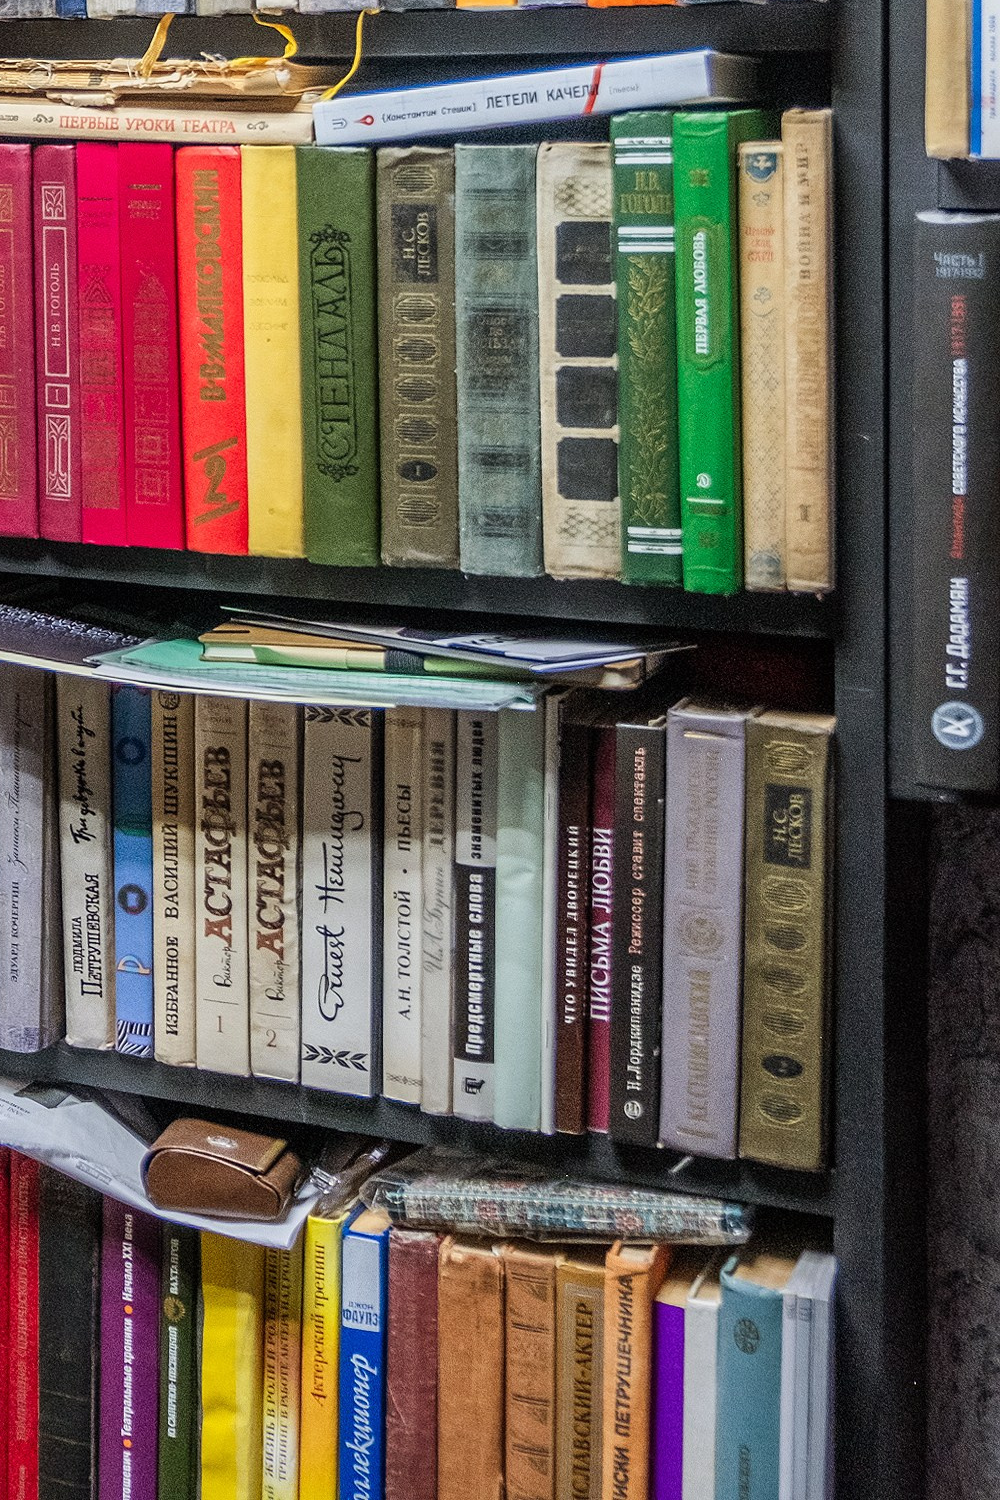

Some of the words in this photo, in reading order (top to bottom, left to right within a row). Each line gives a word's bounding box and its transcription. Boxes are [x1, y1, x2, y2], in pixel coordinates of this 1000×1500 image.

[59, 115, 119, 130] ПЕРВЫЕ
[125, 116, 176, 132] УРОКИ
[182, 119, 236, 134] ТЕАТРА
[418, 212, 429, 276] ЛЕСКОВ
[693, 232, 707, 295] ЛЮБОВЬ
[50, 263, 60, 316] ГОГОЛЬ
[51, 321, 61, 347] Н.В.
[695, 298, 709, 354] ПЕРВАЯ
[946, 576, 968, 659] ДАДАМЯН
[946, 662, 968, 691] Г.Г.
[163, 714, 178, 818] ШУКШИН
[472, 720, 483, 770] людей
[201, 745, 237, 947] АСТАФЬЕВ
[315, 754, 364, 905] Hemingway
[397, 784, 411, 852] ПЬЕСЫ
[471, 775, 482, 860] знаменитых
[787, 793, 806, 862] ЛЕСКОВ
[164, 824, 178, 920] ВАСИЛИЙ
[253, 758, 286, 961] АСТАФЬЕВ
[566, 825, 579, 921] ДВОРЕЦКИЙ
[591, 827, 612, 913] ЛЮБВИ
[468, 873, 482, 924] слова
[71, 916, 84, 974] ЛЮДМИЛА
[397, 891, 411, 979] ТОЛСТОЙ
[564, 927, 577, 987] УВИДЕЛ
[166, 935, 178, 1037] ИЗБРАННОЕ
[213, 945, 233, 988] Виктор
[265, 959, 285, 1001] Виктор
[317, 925, 345, 1022] Ernest
[399, 985, 411, 1002] Н.
[465, 928, 483, 1055] Предсмертные
[589, 921, 611, 1022] ПИСЬМА
[216, 1015, 224, 1034] 1
[265, 1028, 277, 1050] 2
[400, 1003, 411, 1021] А.
[564, 994, 576, 1024] ЧТО
[123, 1213, 133, 1240] века
[122, 1261, 133, 1301] Начало
[169, 1238, 179, 1295] ВАХТАНГОВ
[310, 1241, 329, 1309] тренинг
[123, 1318, 134, 1364] хроники
[343, 1309, 378, 1327] ФАУЛЗ
[310, 1314, 330, 1407] Актерский
[121, 1366, 133, 1437] Театральные
